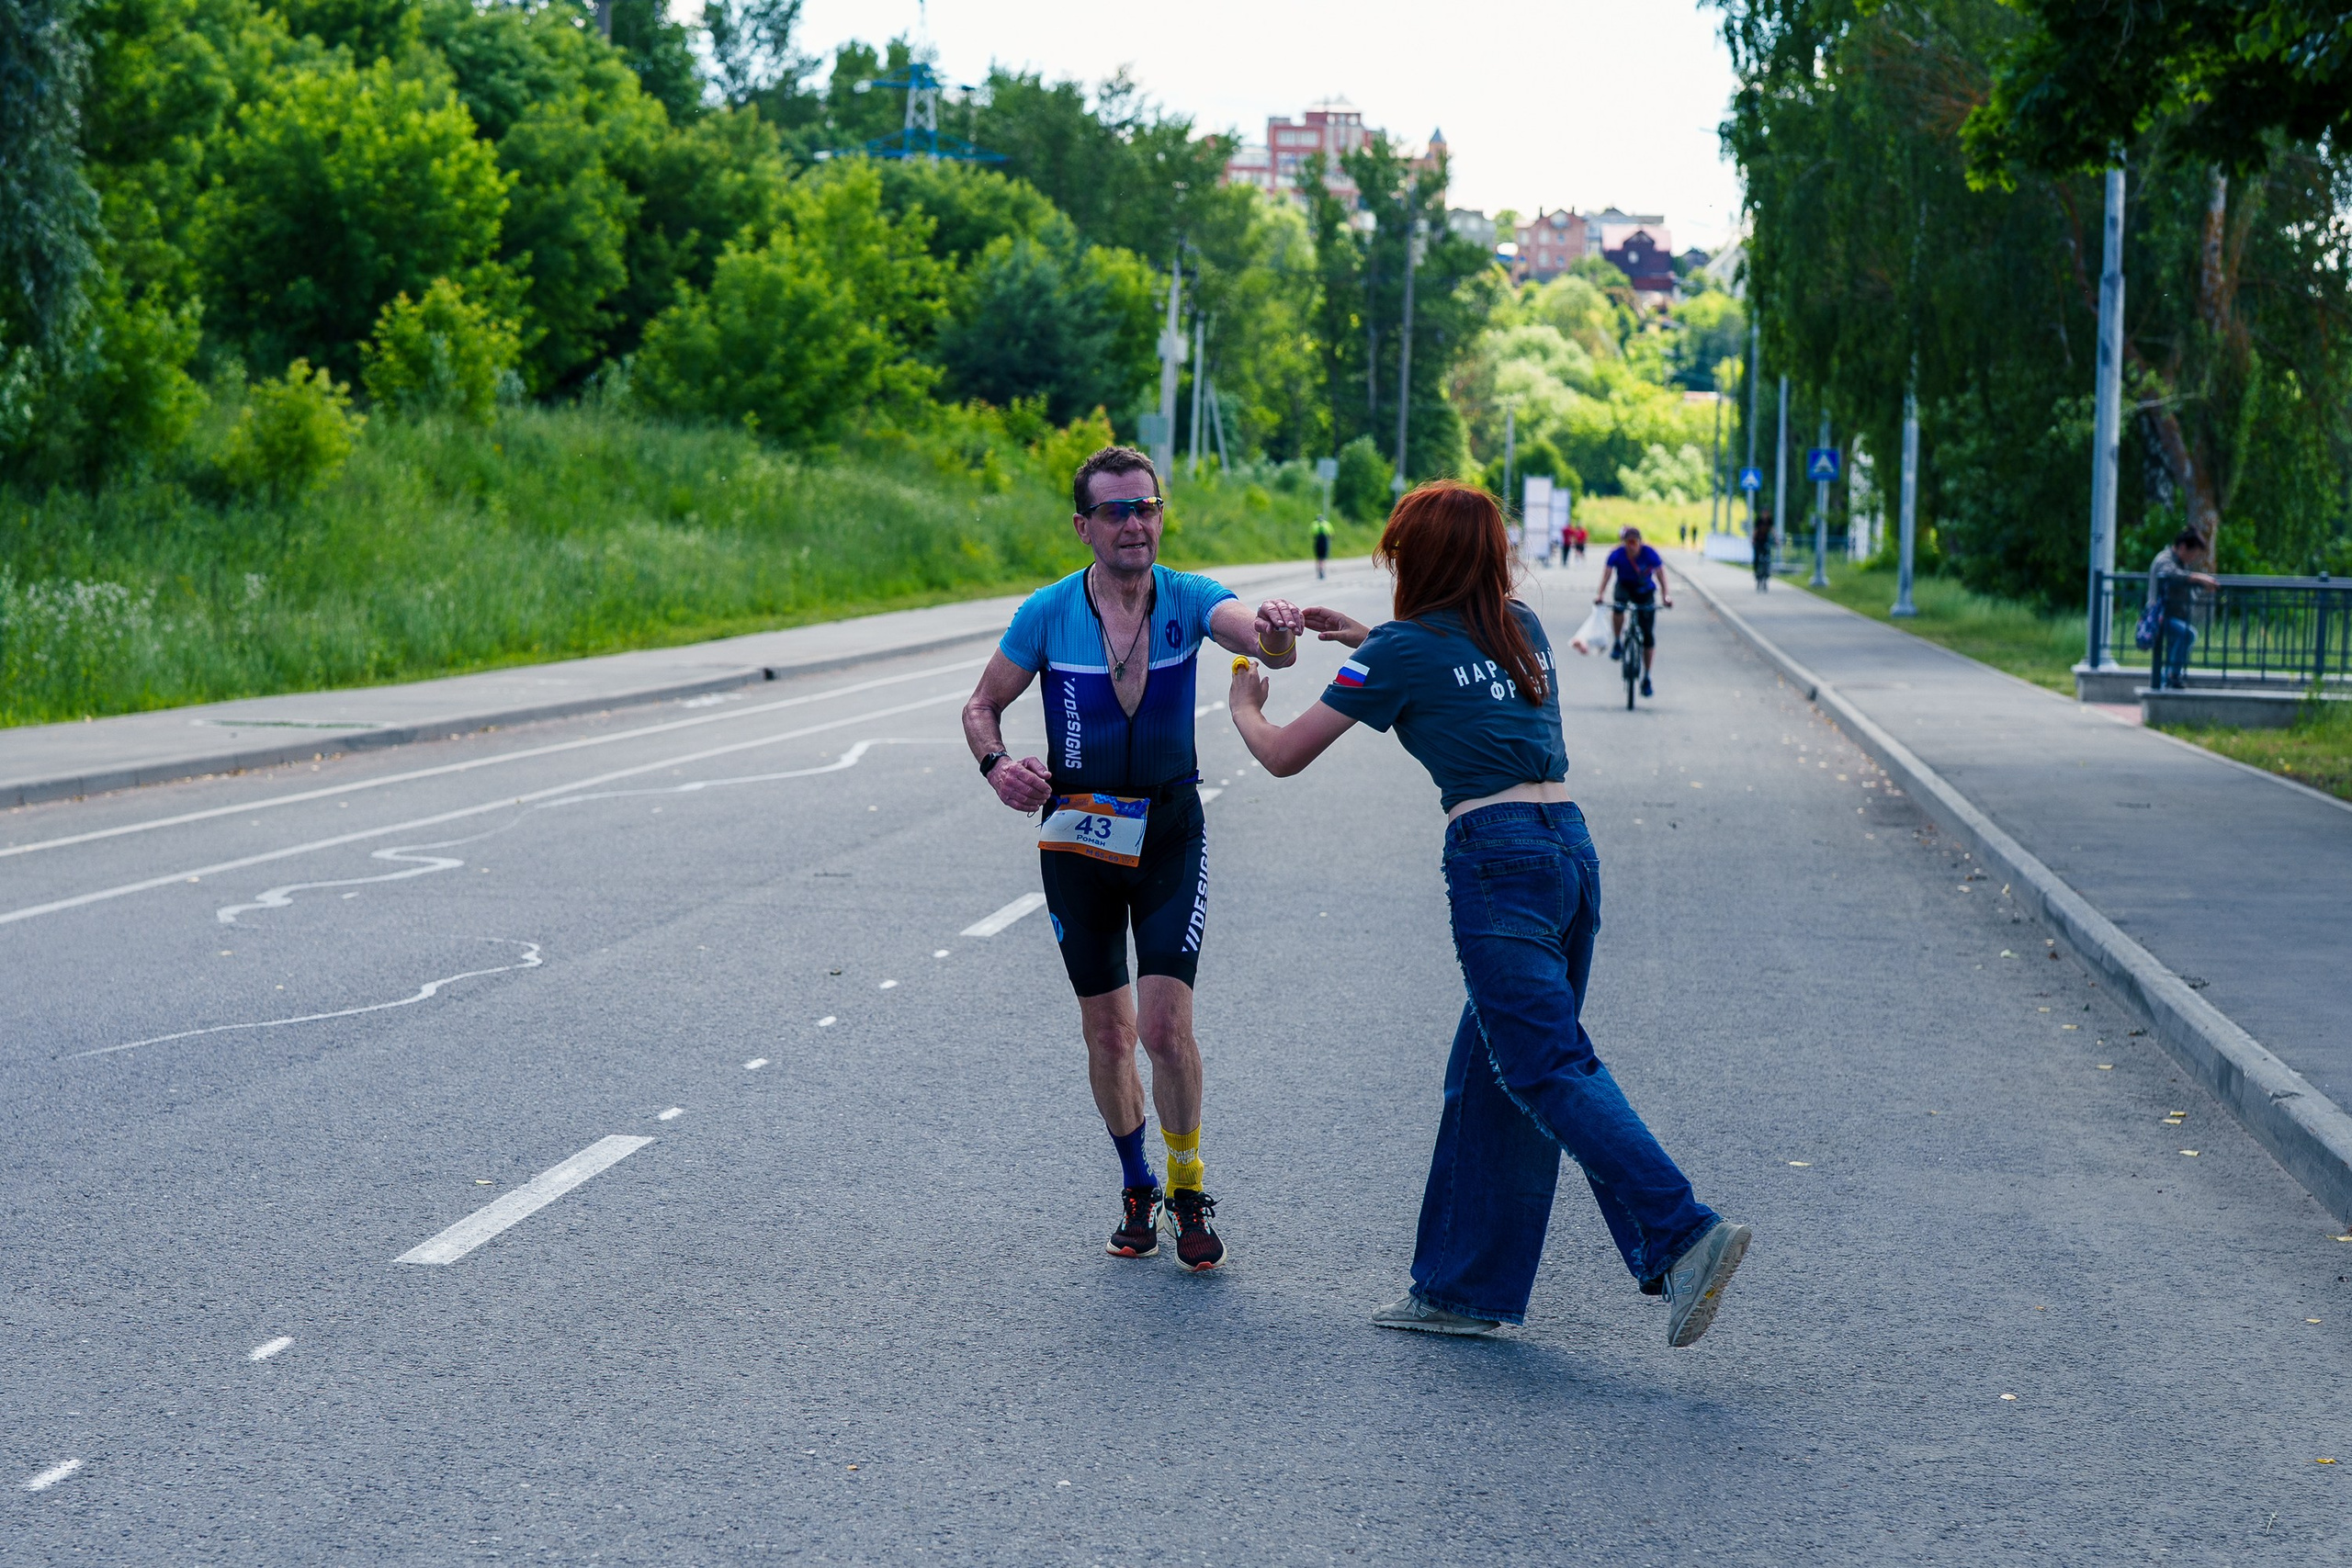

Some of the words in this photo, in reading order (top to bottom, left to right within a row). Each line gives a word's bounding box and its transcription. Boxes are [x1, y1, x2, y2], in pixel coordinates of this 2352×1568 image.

[1453, 647, 1555, 687] НАРЫЙ
[1490, 674, 1550, 701] ФРТ
[1074, 815, 1113, 840] 43
[1076, 834, 1106, 847] Роман
[1094, 851, 1119, 863] 65-69
